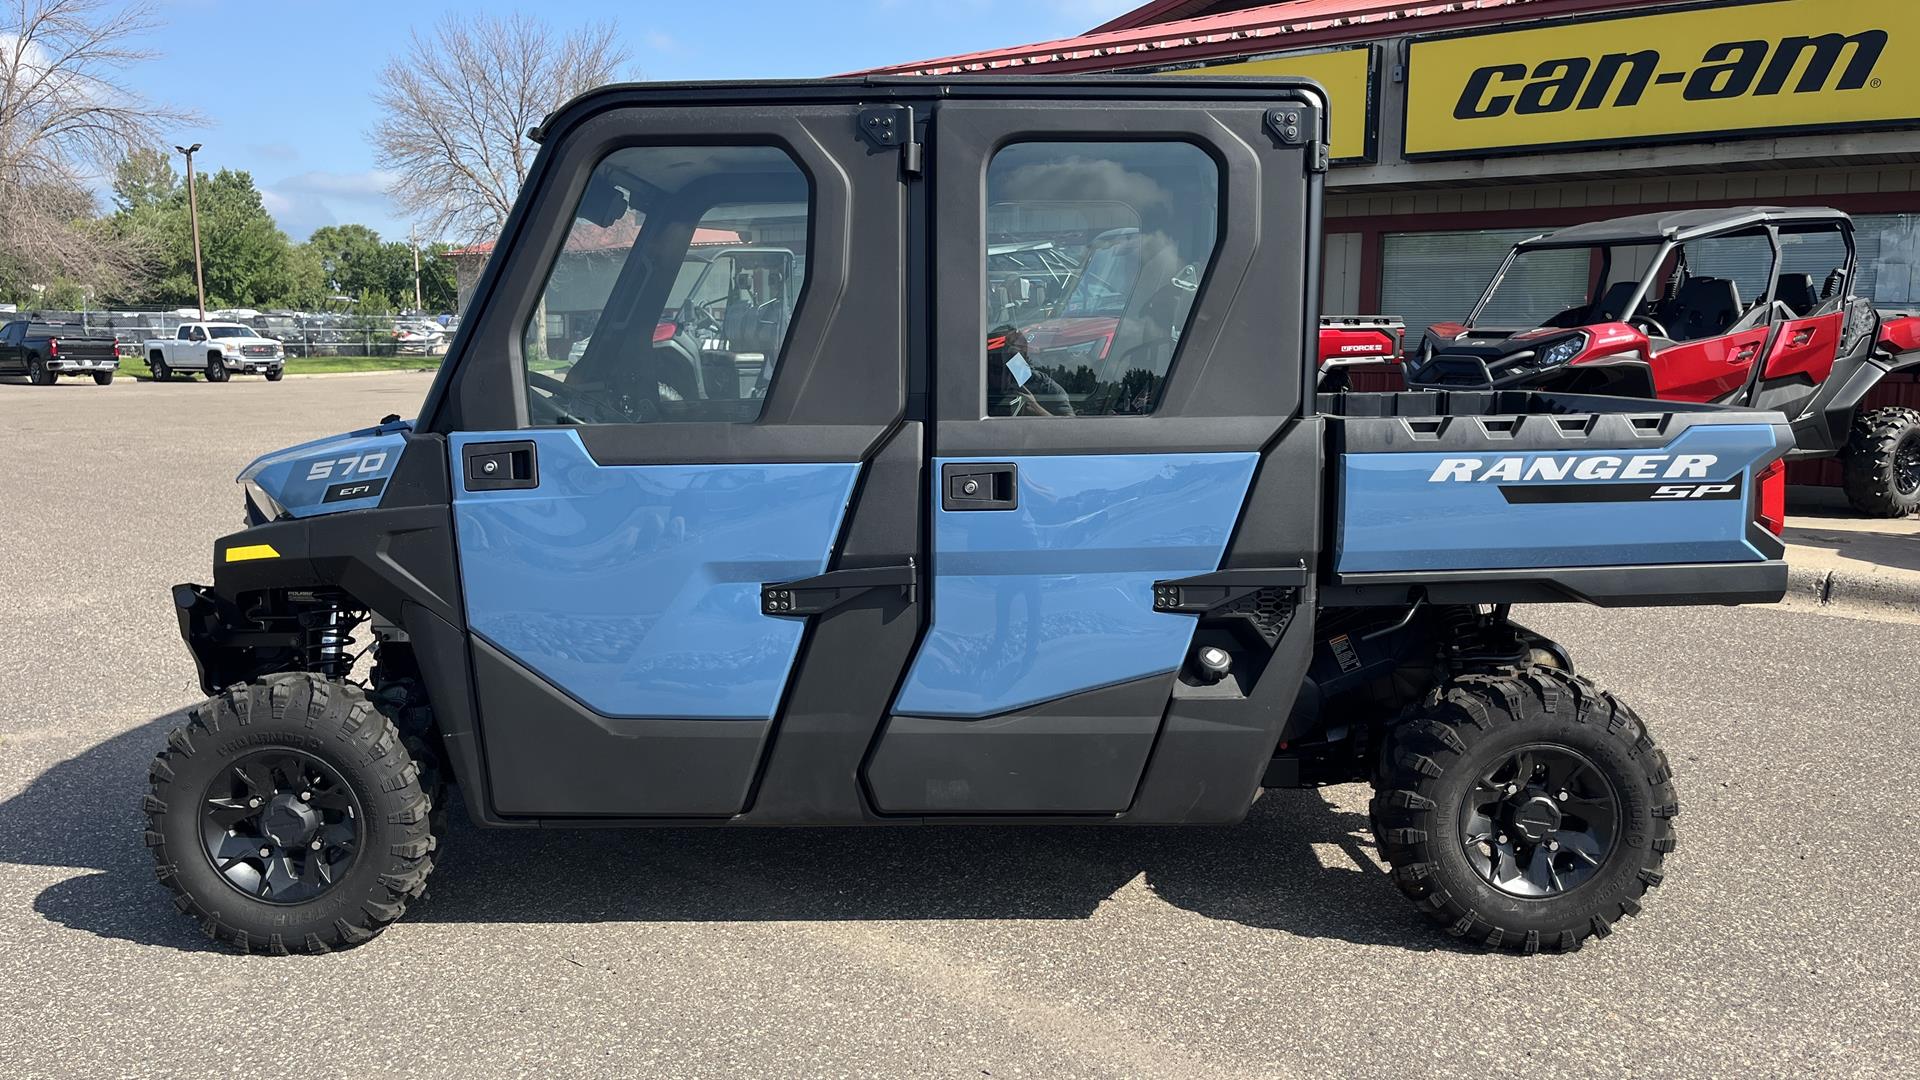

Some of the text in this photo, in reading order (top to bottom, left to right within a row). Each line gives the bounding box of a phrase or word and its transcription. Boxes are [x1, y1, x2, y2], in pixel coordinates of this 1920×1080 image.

[307, 453, 387, 480] 570
[1428, 454, 1718, 482] RANGER
[340, 485, 370, 496] EFI
[1650, 485, 1736, 499] SP
